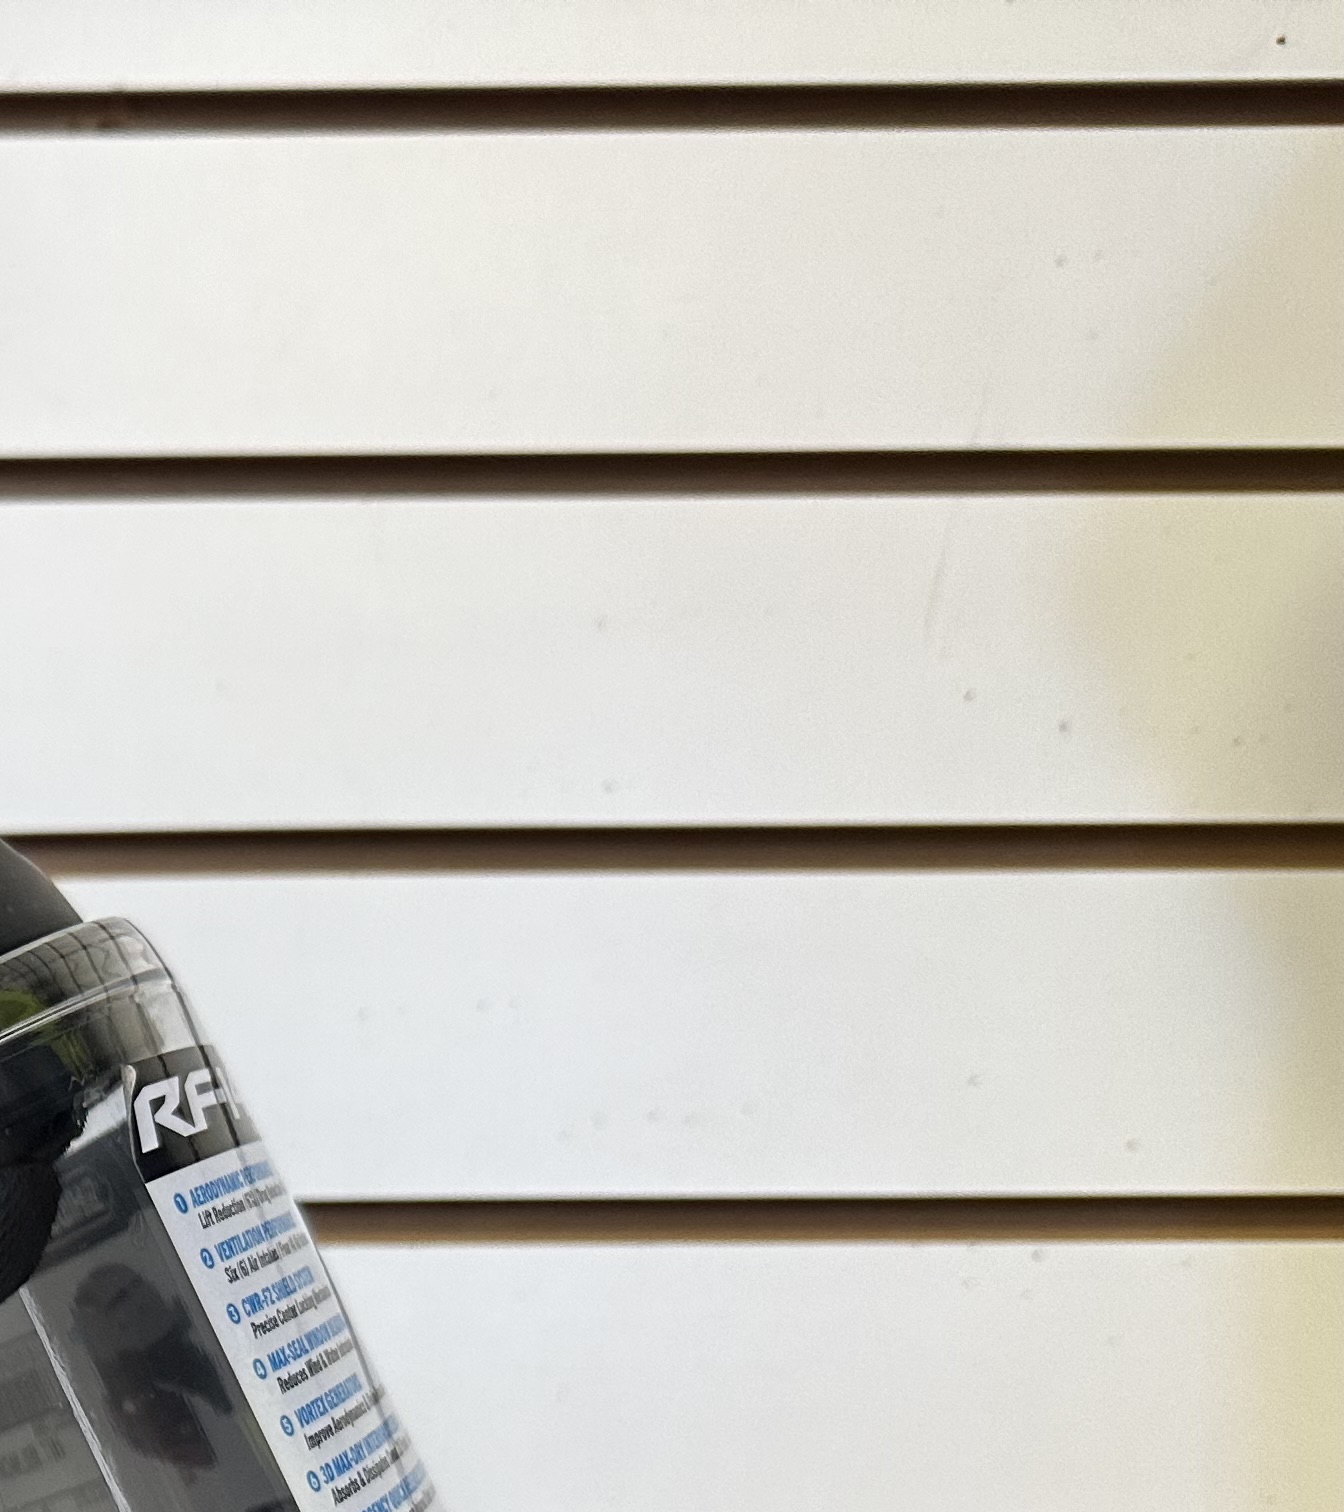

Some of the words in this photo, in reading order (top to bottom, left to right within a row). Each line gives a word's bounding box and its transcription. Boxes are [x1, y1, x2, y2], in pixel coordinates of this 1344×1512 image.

[190, 1172, 244, 1207] AERODYNAMIC
[214, 1226, 265, 1262] VENTILATION
[224, 1265, 240, 1283] Six
[247, 1255, 260, 1273] Air
[242, 1286, 276, 1317] CWR-F2
[250, 1314, 280, 1339] Precise
[267, 1337, 309, 1372] MAX-SEAL
[276, 1368, 309, 1394] Reduces
[294, 1395, 329, 1428] VORTEX
[304, 1424, 335, 1451] Improve
[320, 1462, 335, 1484] 3D
[332, 1442, 366, 1476] MAX-DRY
[331, 1477, 361, 1506] Absorbs
